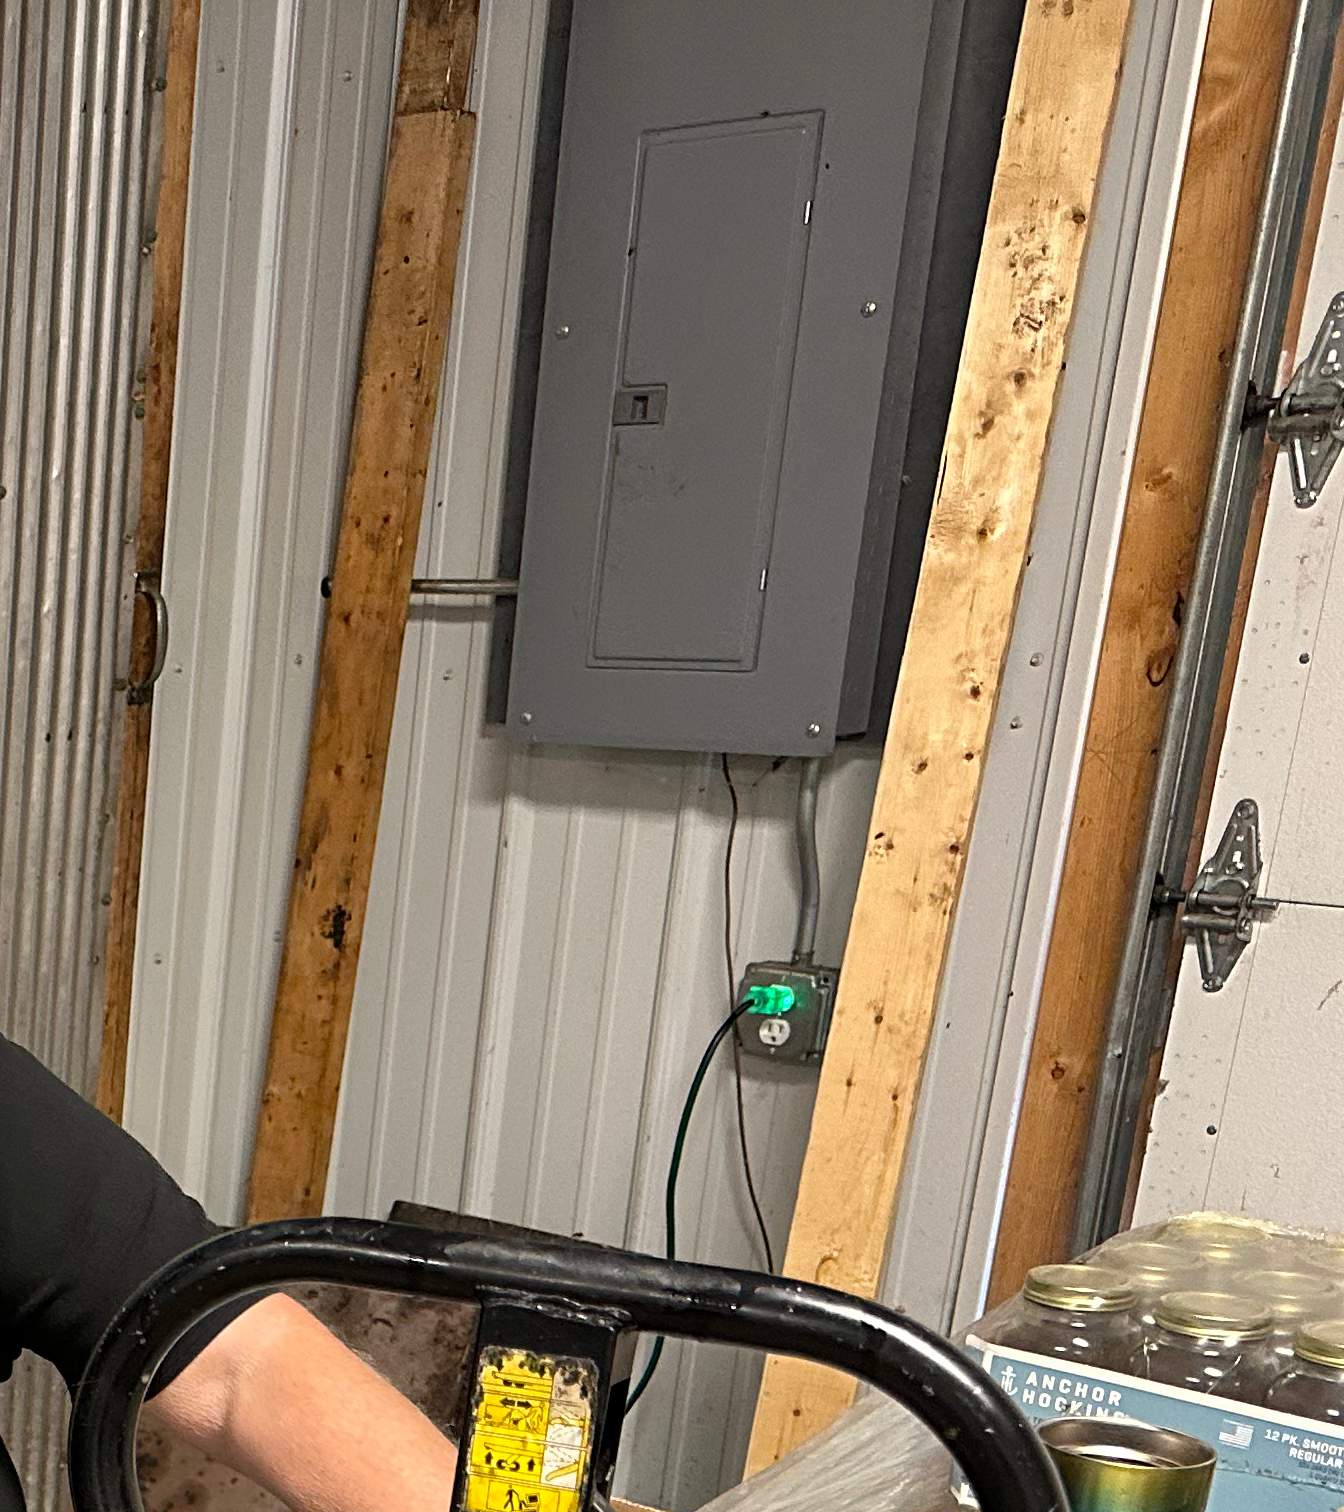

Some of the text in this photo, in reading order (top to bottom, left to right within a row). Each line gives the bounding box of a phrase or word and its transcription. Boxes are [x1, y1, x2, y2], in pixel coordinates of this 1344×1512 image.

[1025, 1371, 1122, 1406] ANCHOR
[1264, 1429, 1280, 1442] 12
[1289, 1447, 1344, 1469] REGULAR
